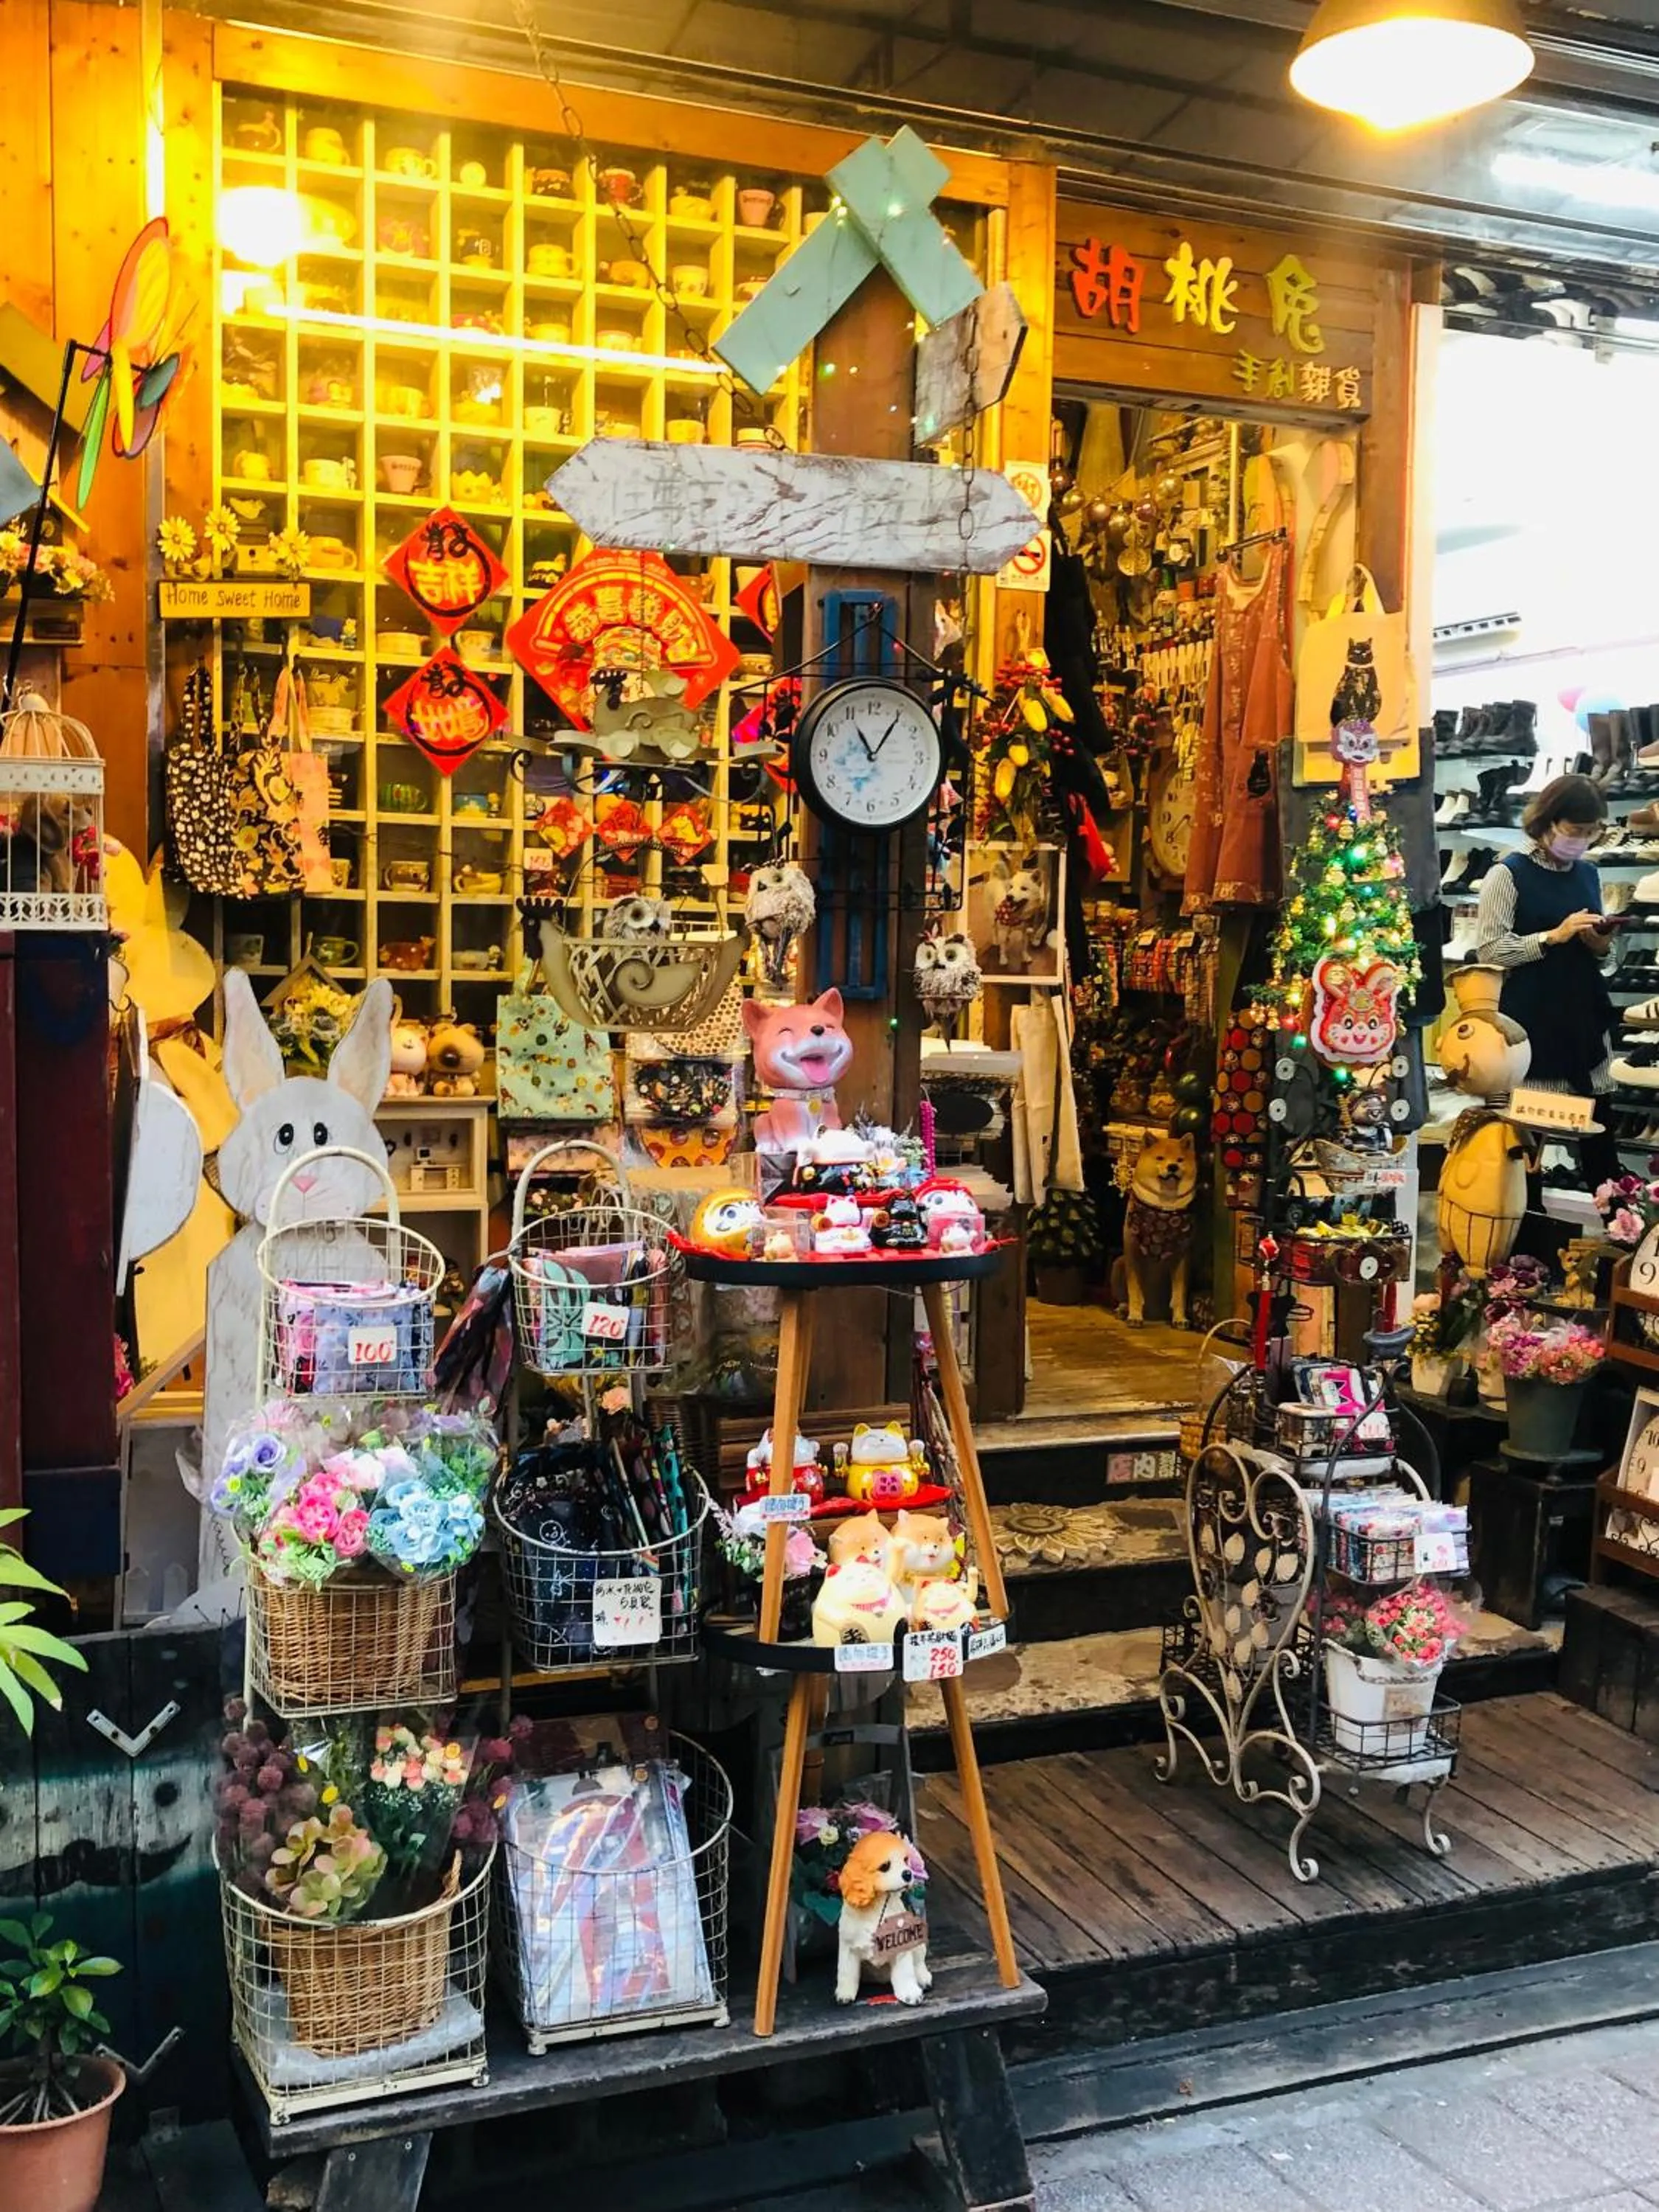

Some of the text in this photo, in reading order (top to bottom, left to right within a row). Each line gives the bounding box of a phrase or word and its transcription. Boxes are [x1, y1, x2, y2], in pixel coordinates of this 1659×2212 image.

[407, 558, 481, 604] 吉祥
[167, 585, 302, 608] Home Sweet Home
[846, 706, 855, 720] 11
[868, 701, 882, 716] 12
[827, 723, 839, 737] 10
[908, 726, 918, 740] 2
[819, 748, 828, 763] 9
[914, 751, 924, 765] 3
[826, 775, 835, 789] 8
[908, 775, 917, 790] 4
[845, 791, 852, 806] 7
[866, 799, 876, 812] 6
[889, 791, 900, 807] 5
[1639, 1262, 1657, 1286] 9
[588, 1315, 622, 1338] 120
[355, 1342, 392, 1363] 100
[1637, 1457, 1646, 1474] 9
[930, 1646, 956, 1661] 250
[930, 1662, 956, 1679] 150
